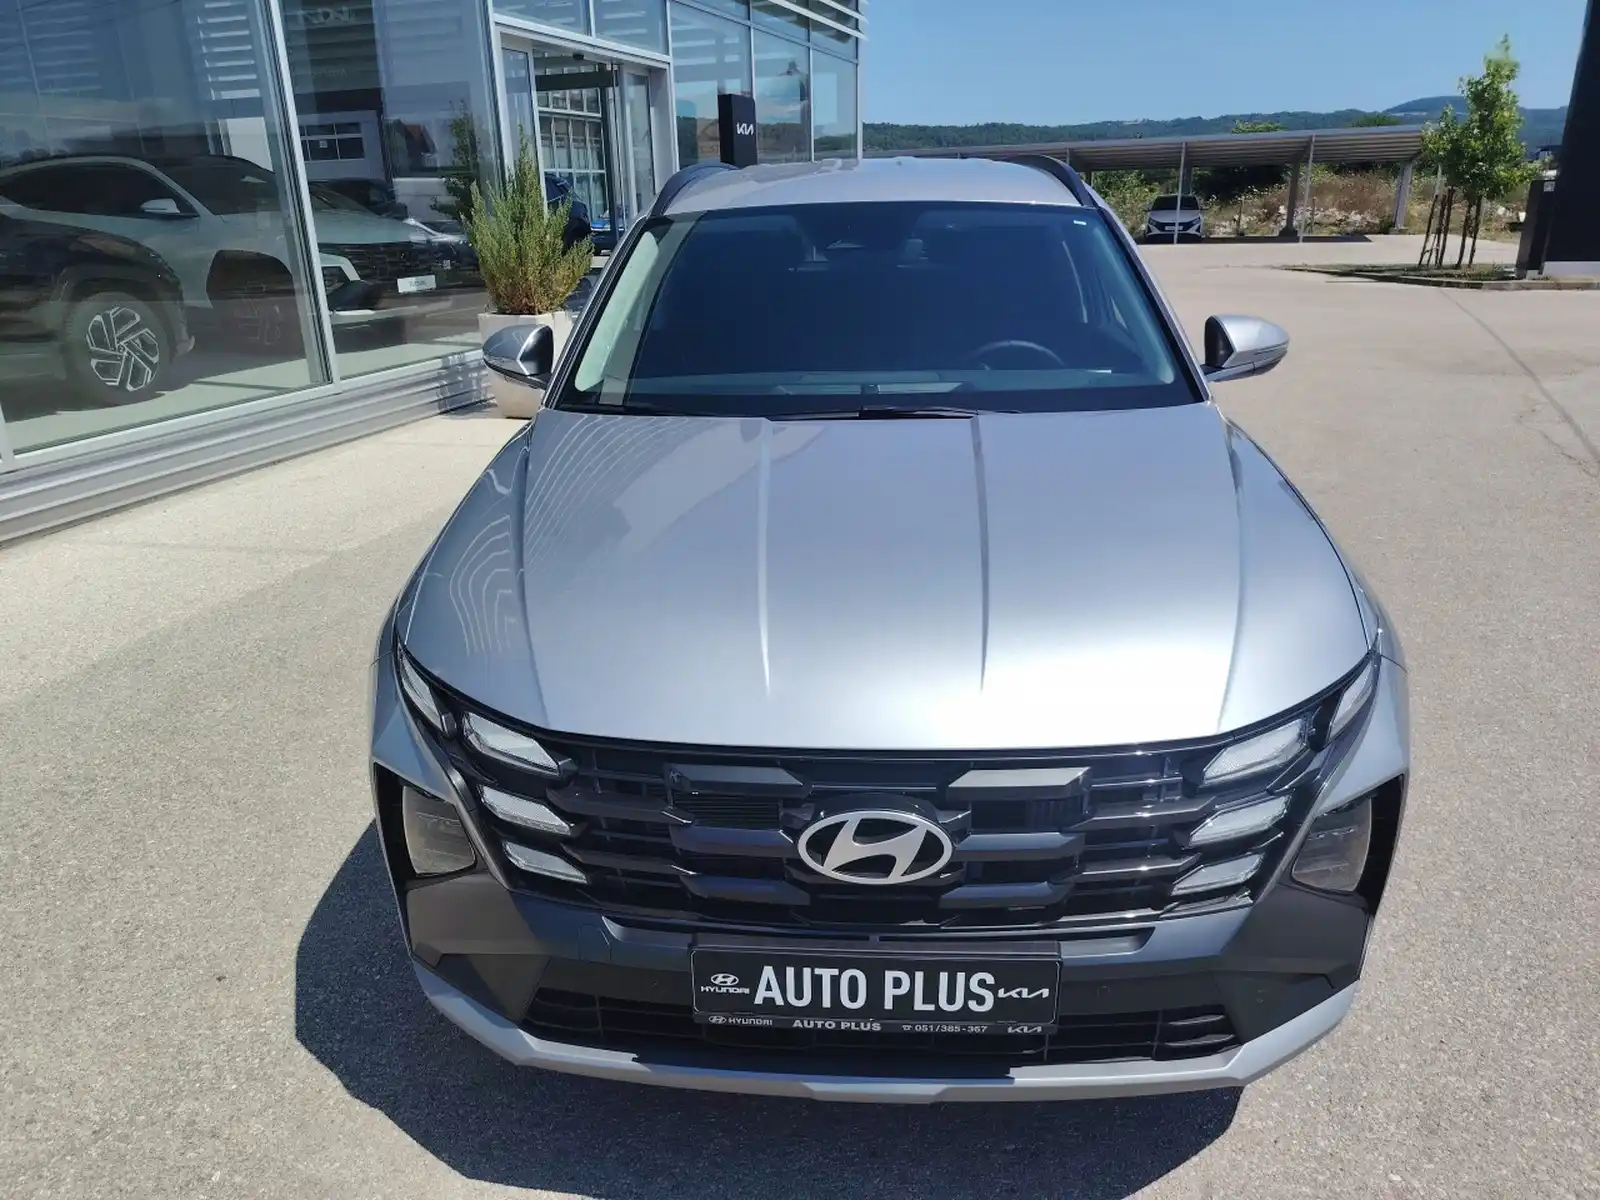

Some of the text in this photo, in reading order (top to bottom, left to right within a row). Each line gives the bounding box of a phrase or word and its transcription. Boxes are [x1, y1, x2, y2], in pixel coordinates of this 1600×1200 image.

[736, 122, 754, 136] KIA
[700, 985, 750, 995] HYUNDAI
[754, 965, 995, 1013] AUTO PLUS
[997, 987, 1050, 999] KIA
[727, 1016, 773, 1026] HYUNDAI
[792, 1019, 882, 1031] AUTO PLUS
[1007, 1025, 1042, 1034] KIA
